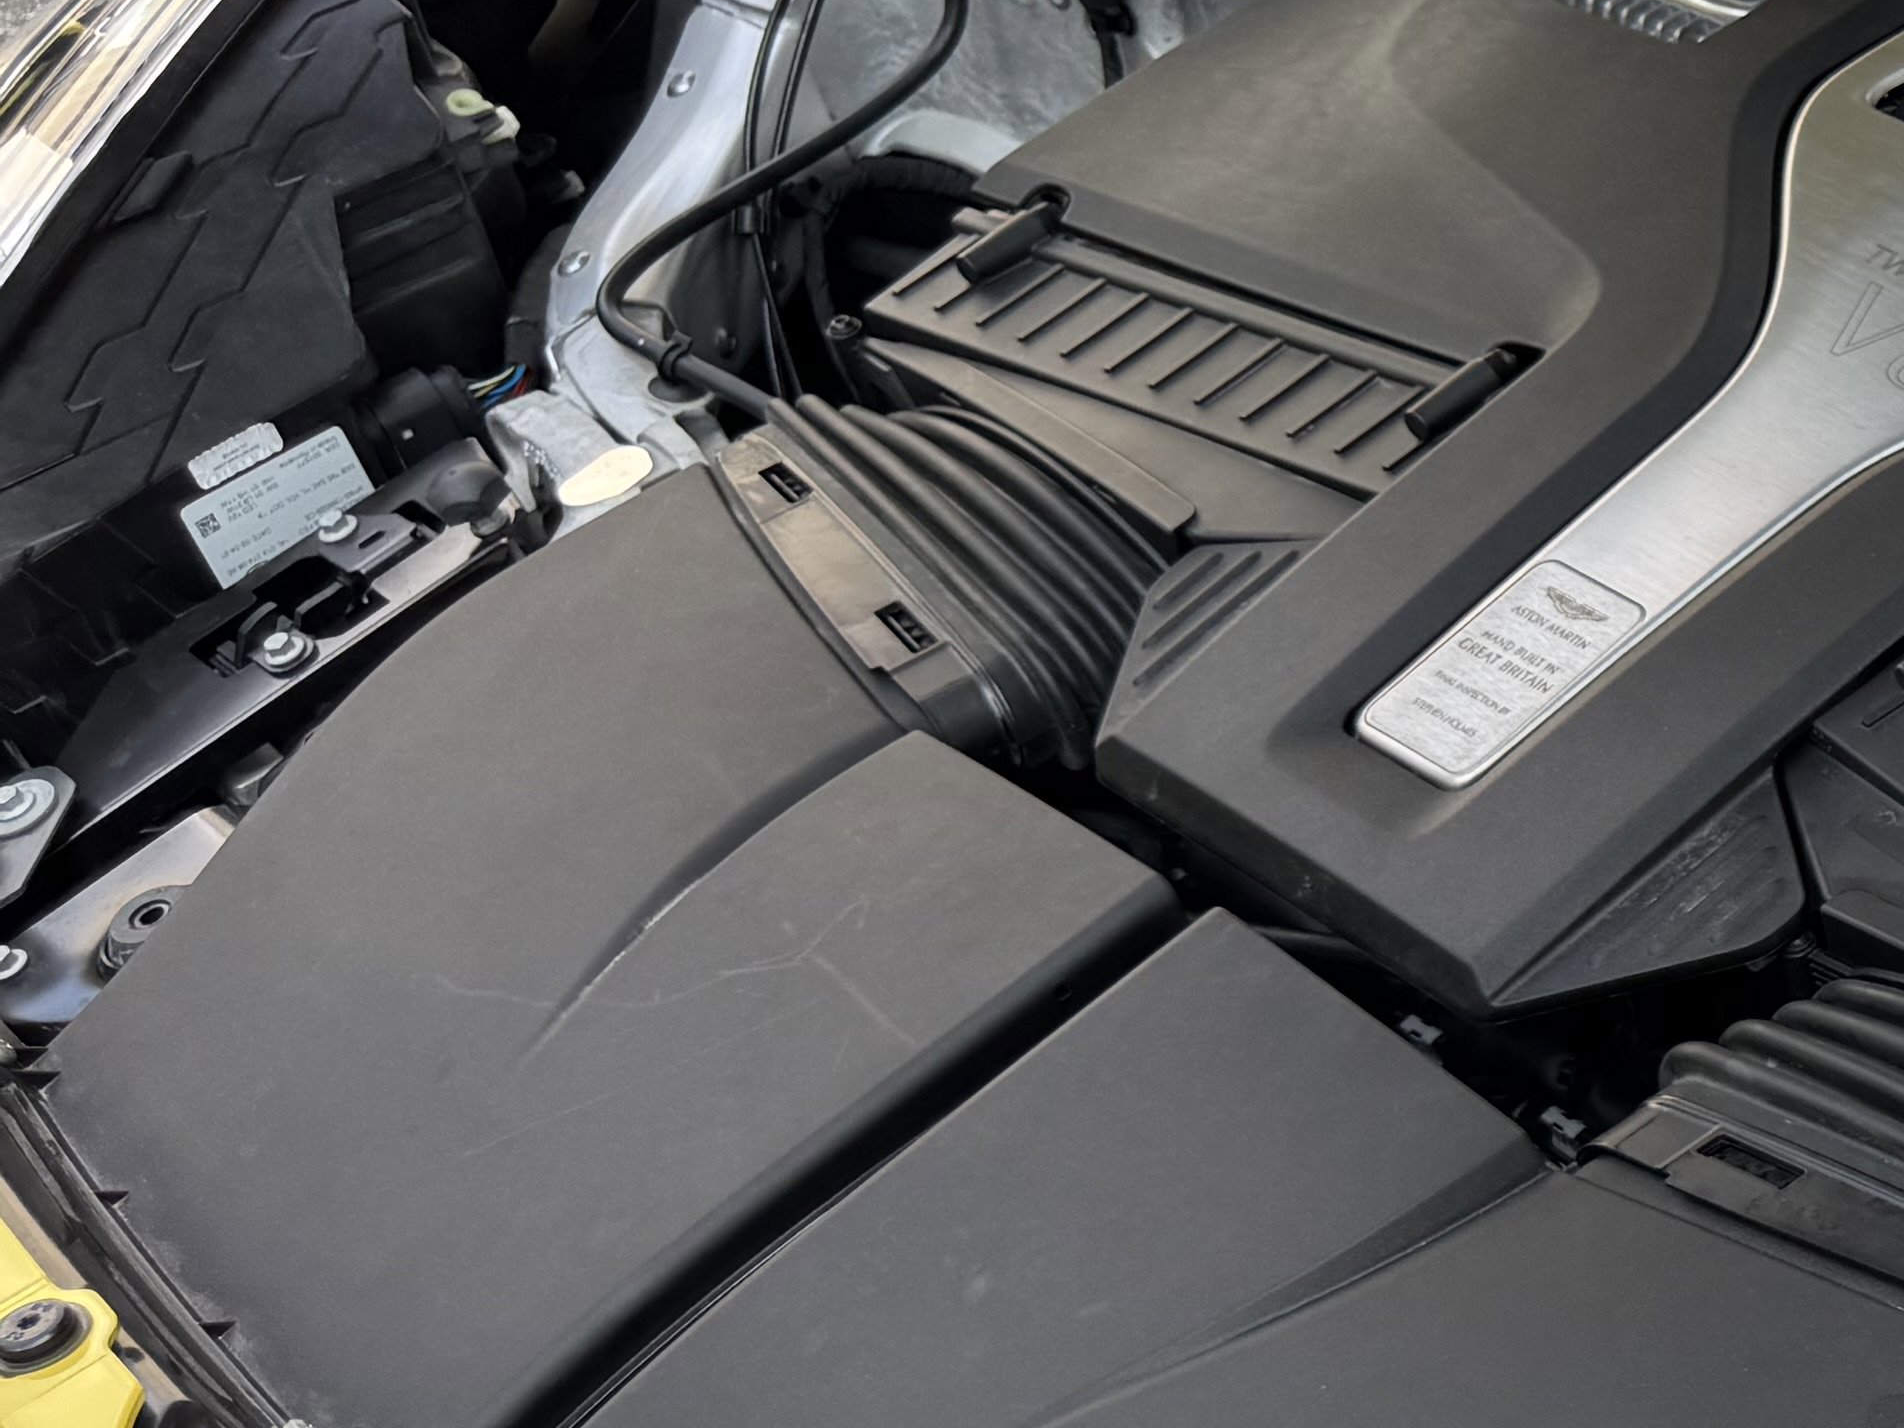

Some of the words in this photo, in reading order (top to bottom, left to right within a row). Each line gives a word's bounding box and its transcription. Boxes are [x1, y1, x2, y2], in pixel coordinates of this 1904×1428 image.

[1510, 605, 1547, 628] ASTON
[1547, 621, 1592, 650] MARTIN
[1458, 636, 1502, 665] GREAT
[1499, 659, 1555, 695] BRITAIN
[1481, 630, 1516, 652] HAND
[1514, 644, 1547, 668] BUILT
[1545, 660, 1562, 675] IN
